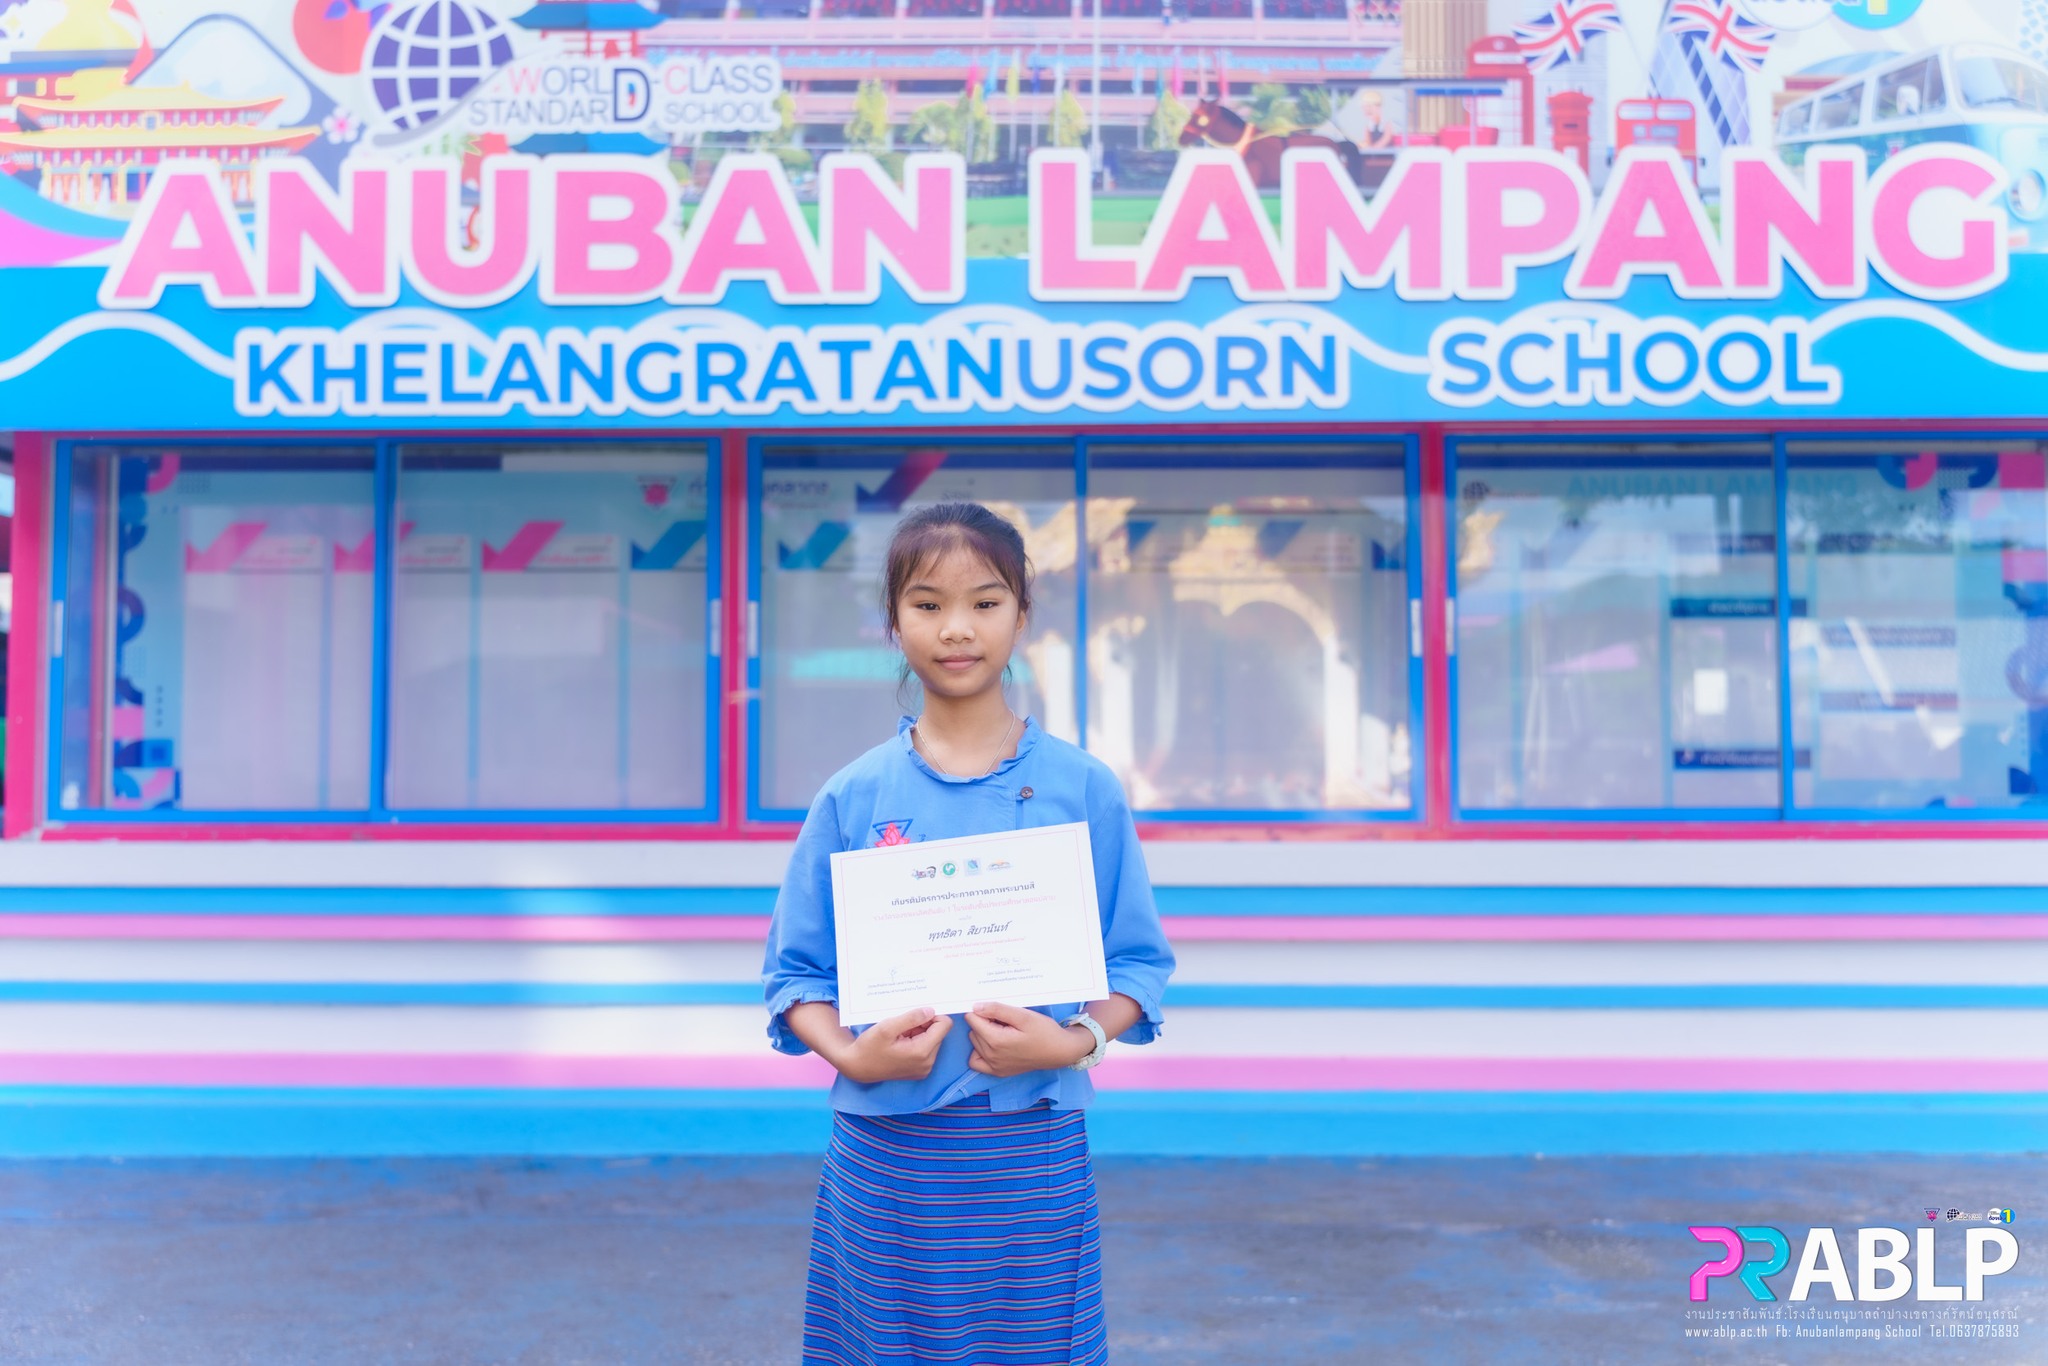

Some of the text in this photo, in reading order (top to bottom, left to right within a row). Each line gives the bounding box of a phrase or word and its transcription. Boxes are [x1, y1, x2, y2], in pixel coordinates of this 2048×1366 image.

[664, 102, 773, 124] SCHOOL
[112, 157, 1998, 298] ANUBAN LAMPANG
[247, 330, 1830, 405] KHELANGRATANUSORN SCHOOL
